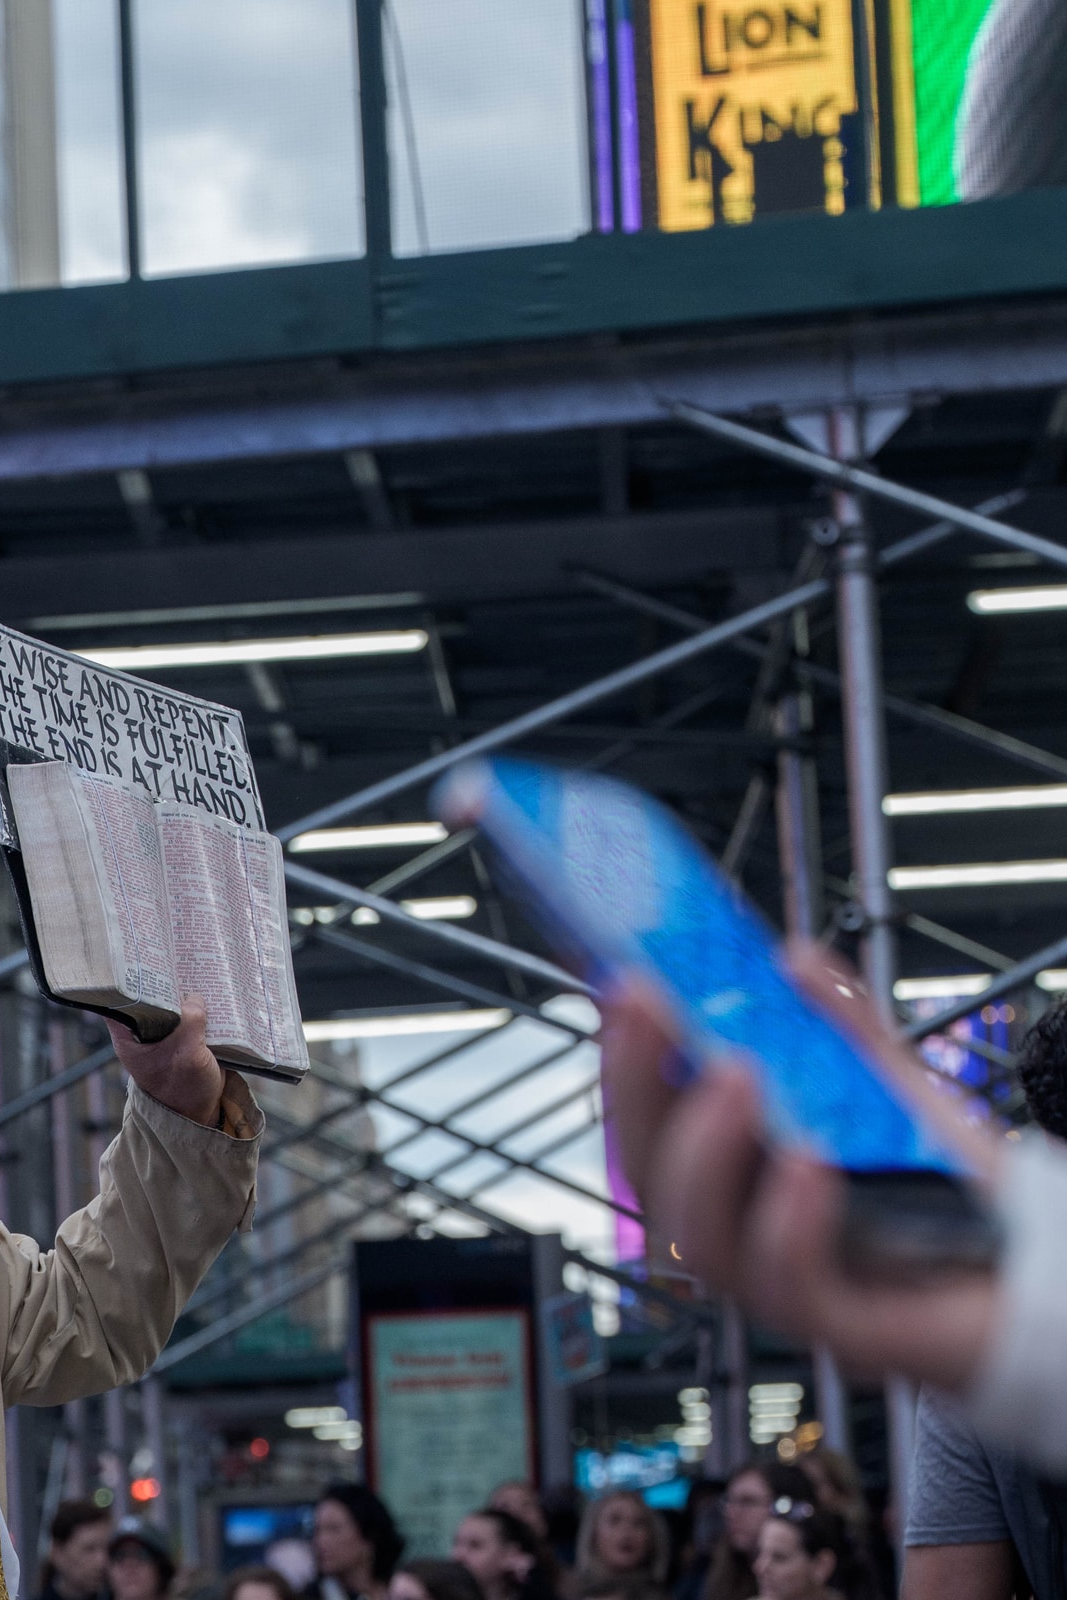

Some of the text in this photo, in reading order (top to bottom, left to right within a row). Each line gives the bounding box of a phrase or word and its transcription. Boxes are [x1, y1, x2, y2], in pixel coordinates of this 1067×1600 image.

[8, 639, 73, 697] WISE
[80, 669, 130, 716] AND
[133, 688, 236, 750] REPENT.
[32, 683, 94, 739] TIME
[96, 703, 120, 747] IS
[45, 725, 98, 772] END
[100, 741, 123, 778] IS
[131, 756, 163, 798] AT
[170, 768, 252, 829] HAND.
